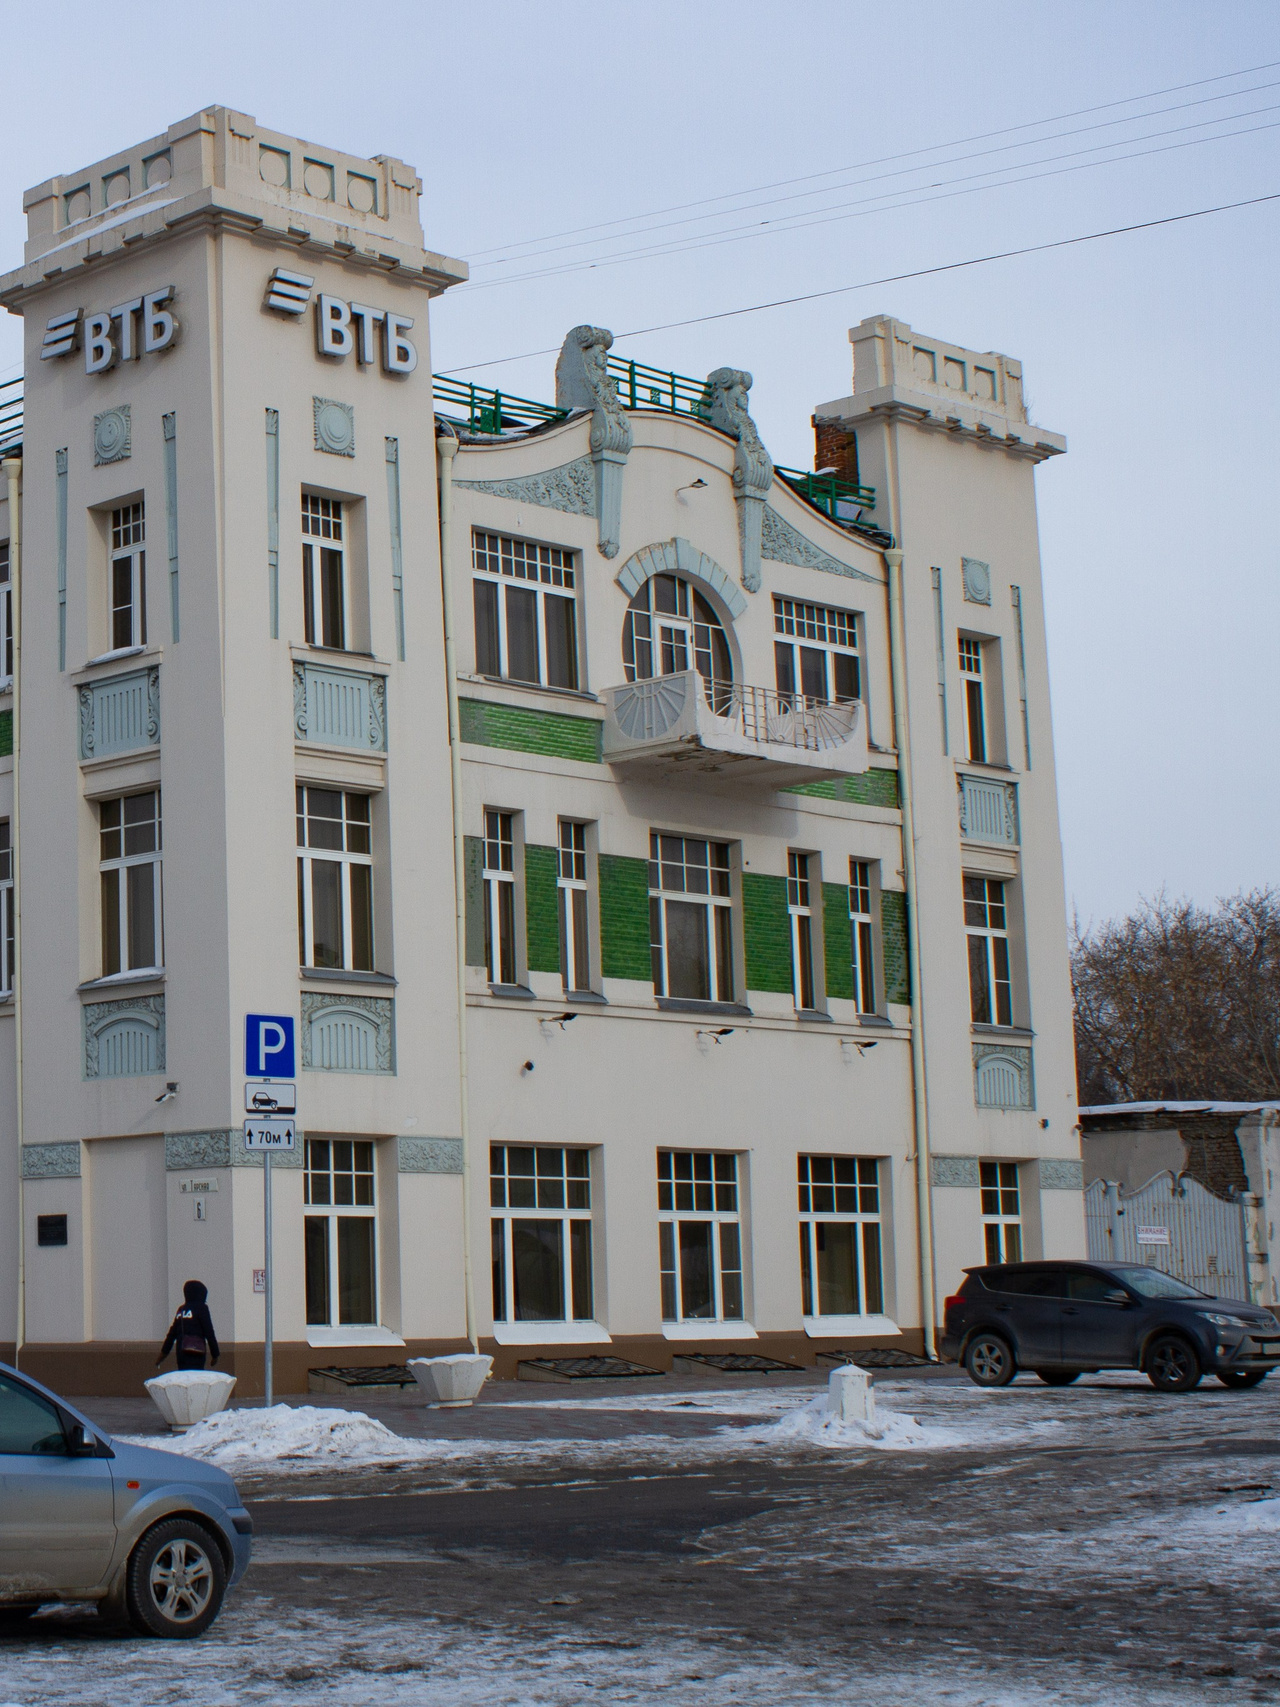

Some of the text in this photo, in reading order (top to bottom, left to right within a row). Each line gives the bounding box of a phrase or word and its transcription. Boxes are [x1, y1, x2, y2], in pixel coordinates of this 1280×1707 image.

[83, 285, 176, 375] ВТБ
[316, 293, 419, 375] ВТБ
[258, 1021, 286, 1071] P
